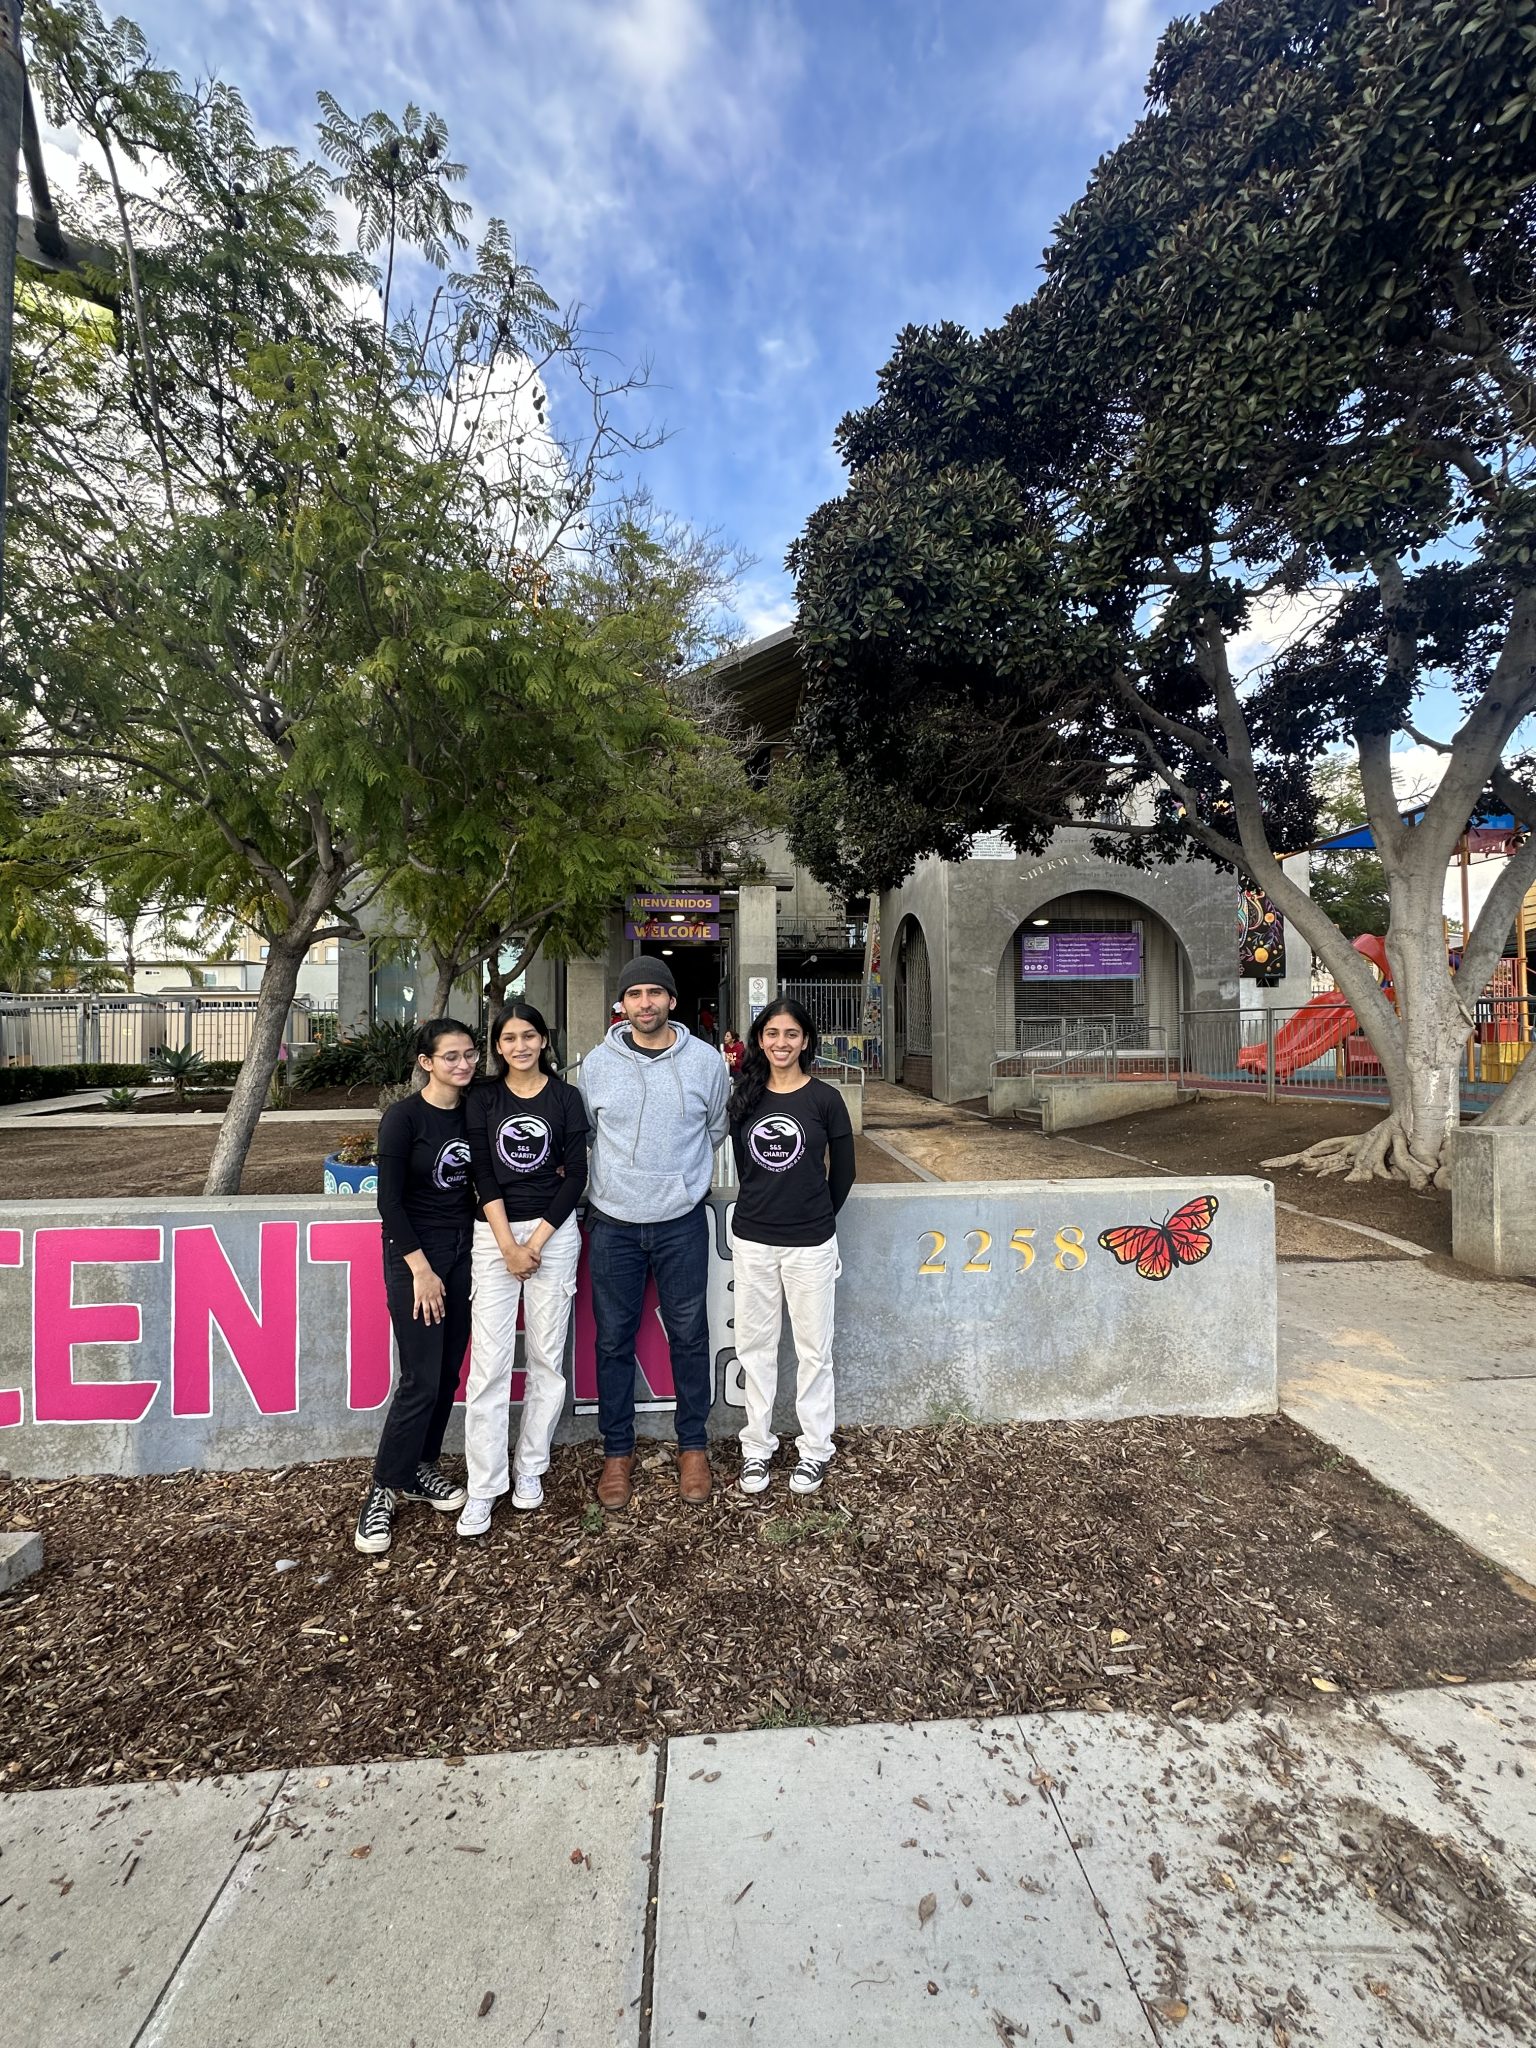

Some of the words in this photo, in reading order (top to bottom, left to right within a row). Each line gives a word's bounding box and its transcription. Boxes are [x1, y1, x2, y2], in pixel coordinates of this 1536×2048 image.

[634, 925, 712, 938] WELCOME
[510, 1151, 537, 1159] CHARITY
[917, 1225, 1088, 1274] 2258
